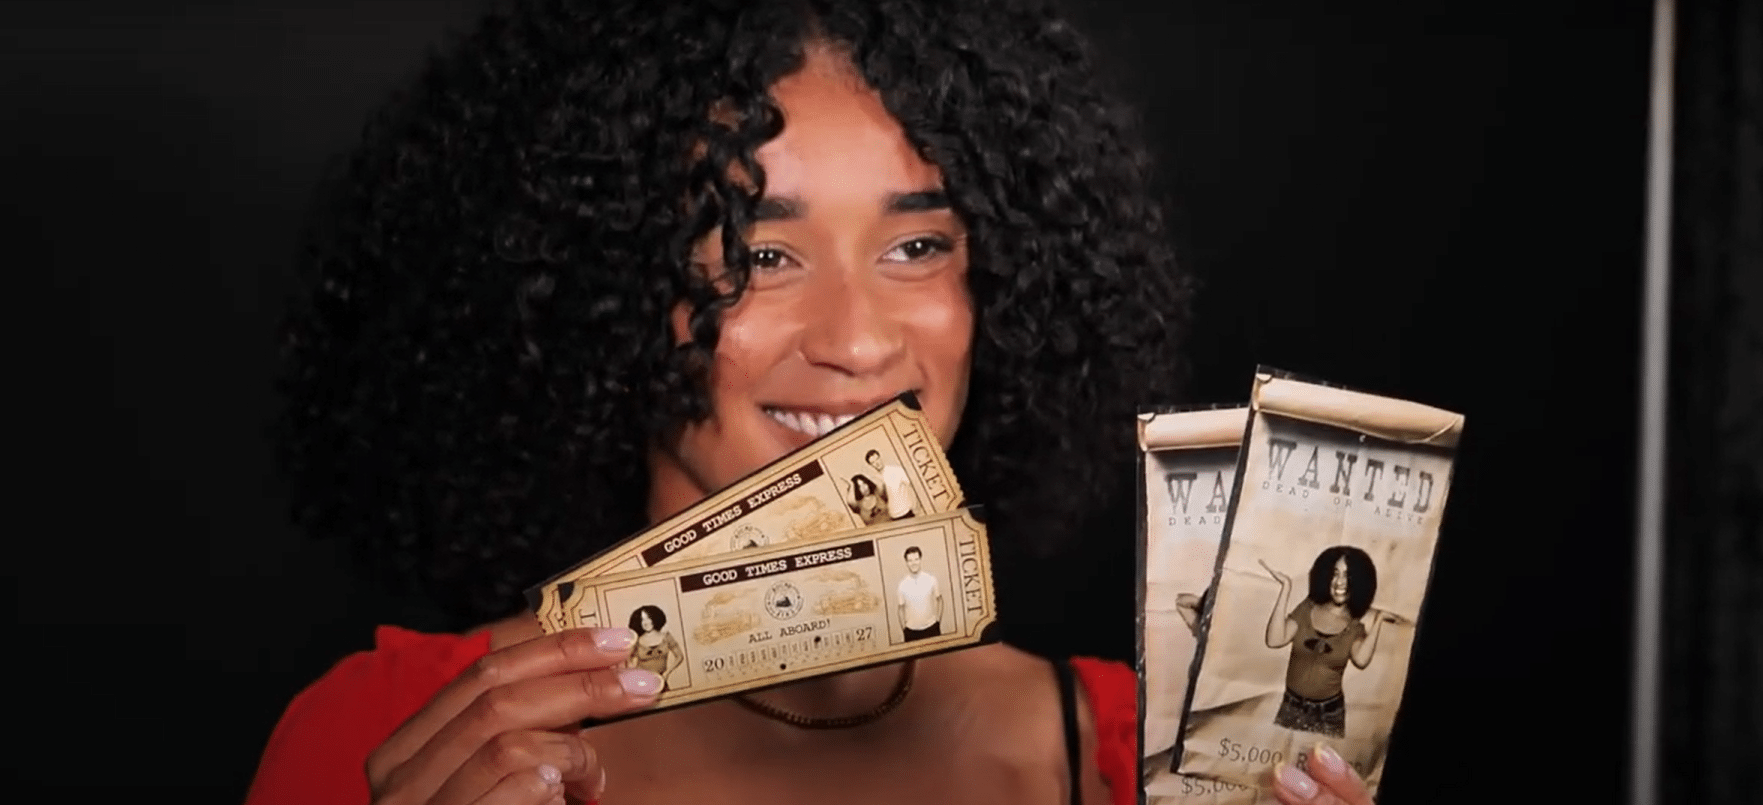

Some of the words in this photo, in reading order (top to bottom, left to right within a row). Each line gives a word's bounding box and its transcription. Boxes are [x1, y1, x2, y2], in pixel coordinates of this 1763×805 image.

[903, 423, 950, 500] TICKET
[1268, 438, 1433, 513] WANTED
[1263, 480, 1310, 498] DEAD
[1333, 496, 1352, 508] OR
[664, 529, 697, 553] GOOD
[702, 505, 742, 532] TIMES
[747, 473, 802, 508] EXPRESS
[1168, 515, 1221, 526] DEAD
[703, 569, 738, 585] GOOD
[745, 560, 787, 577] TIMES
[795, 547, 852, 568] EXPRESS
[959, 534, 984, 616] TICKET
[748, 630, 773, 644] ALL
[780, 618, 831, 638] ABOARD!
[856, 626, 873, 642] 27
[704, 657, 725, 673] 20
